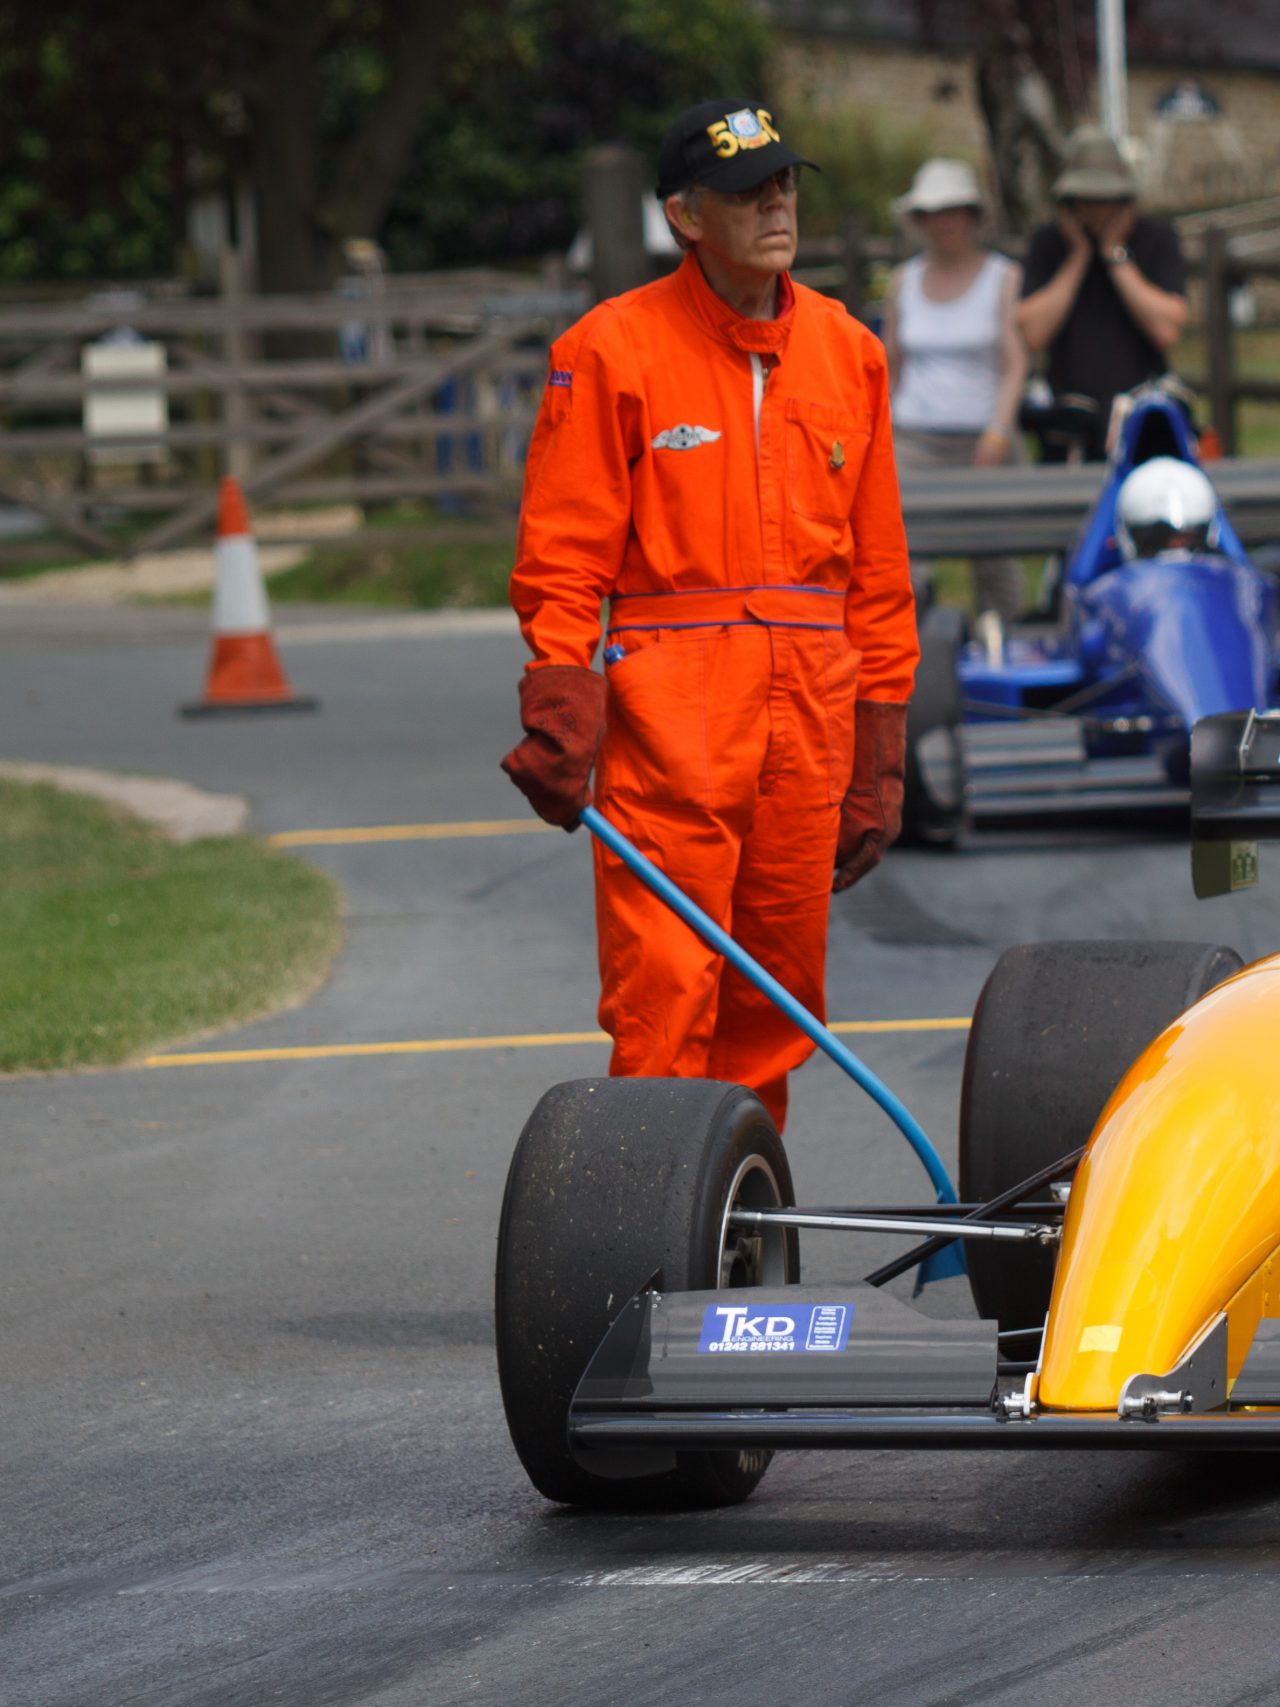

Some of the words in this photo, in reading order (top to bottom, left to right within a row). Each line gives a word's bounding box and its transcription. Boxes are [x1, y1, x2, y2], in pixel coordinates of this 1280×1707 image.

[716, 1306, 795, 1342] TKD
[709, 1341, 748, 1352] 01242
[750, 1341, 795, 1351] 581341
